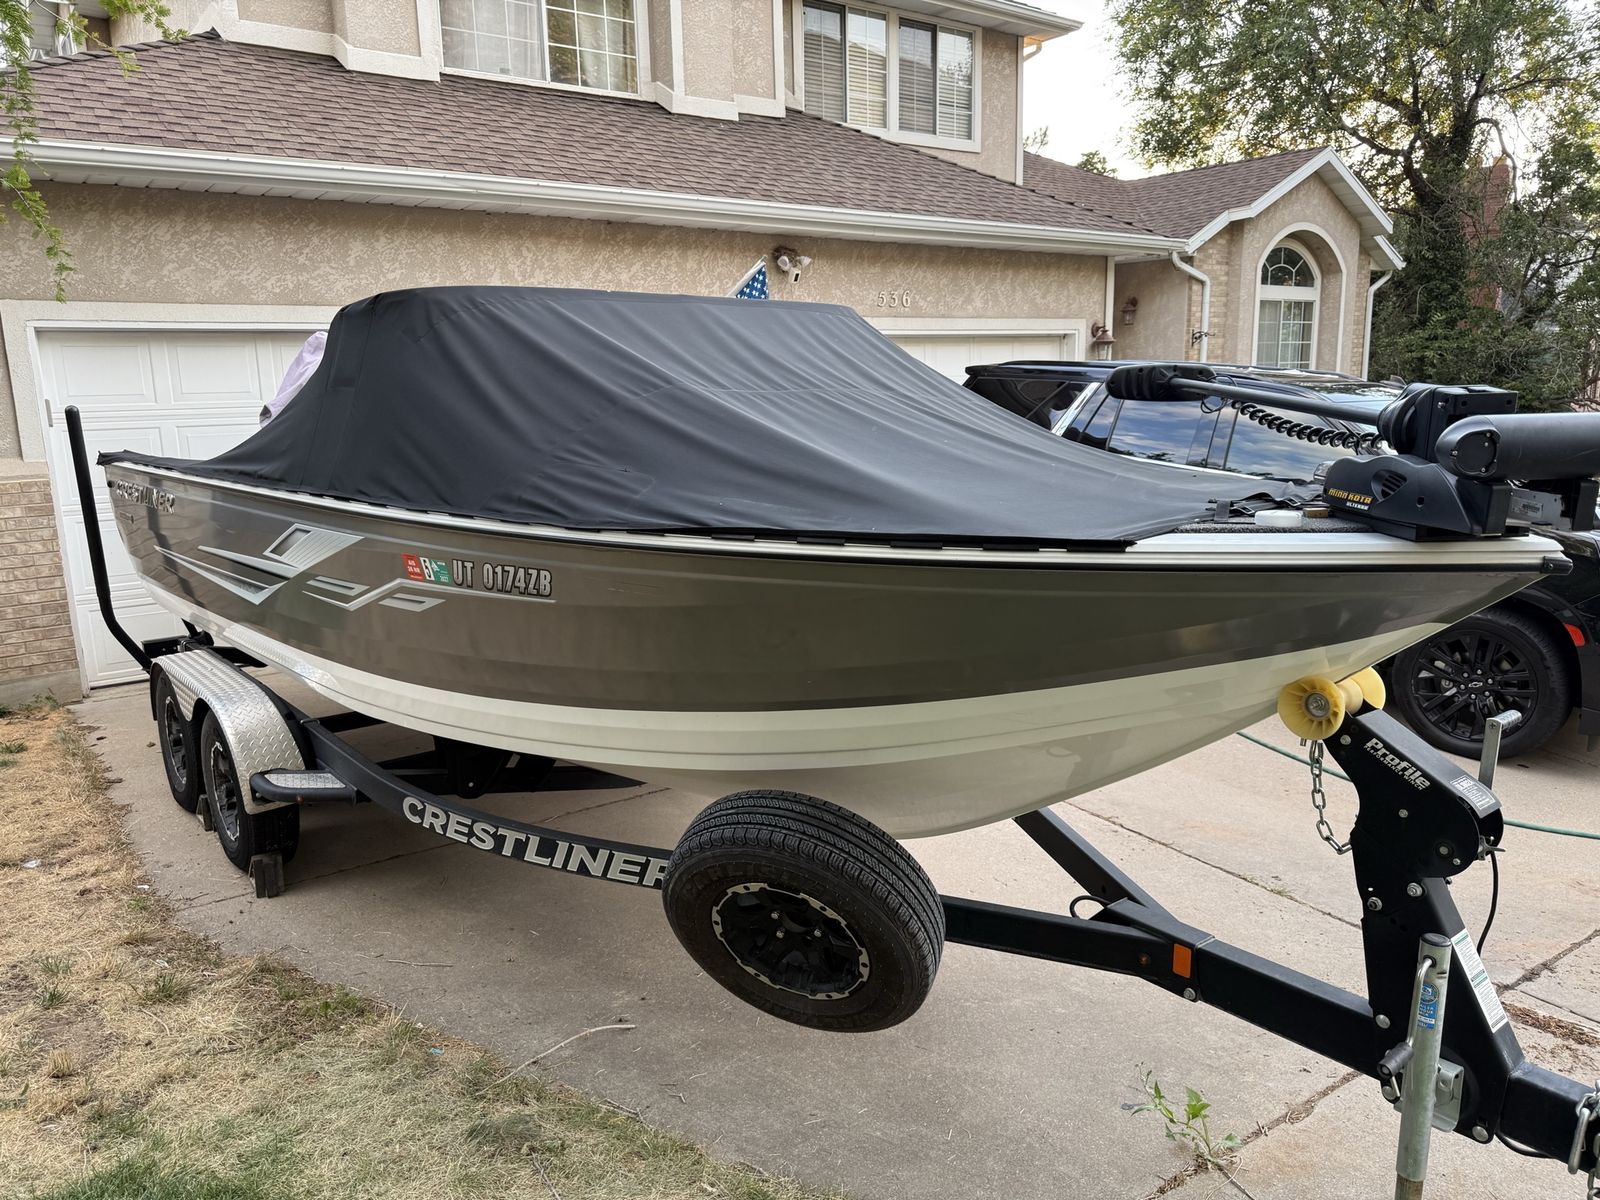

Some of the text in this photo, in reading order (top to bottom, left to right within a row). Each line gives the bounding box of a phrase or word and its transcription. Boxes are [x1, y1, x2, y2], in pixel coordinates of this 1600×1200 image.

[877, 290, 911, 308] 536
[116, 480, 175, 514] CRESTLINER
[1348, 492, 1372, 504] KOTA
[452, 559, 552, 597] UT 0174ZB
[1363, 745, 1425, 791] PERFORMANCE WINCH
[1366, 738, 1431, 789] Profile
